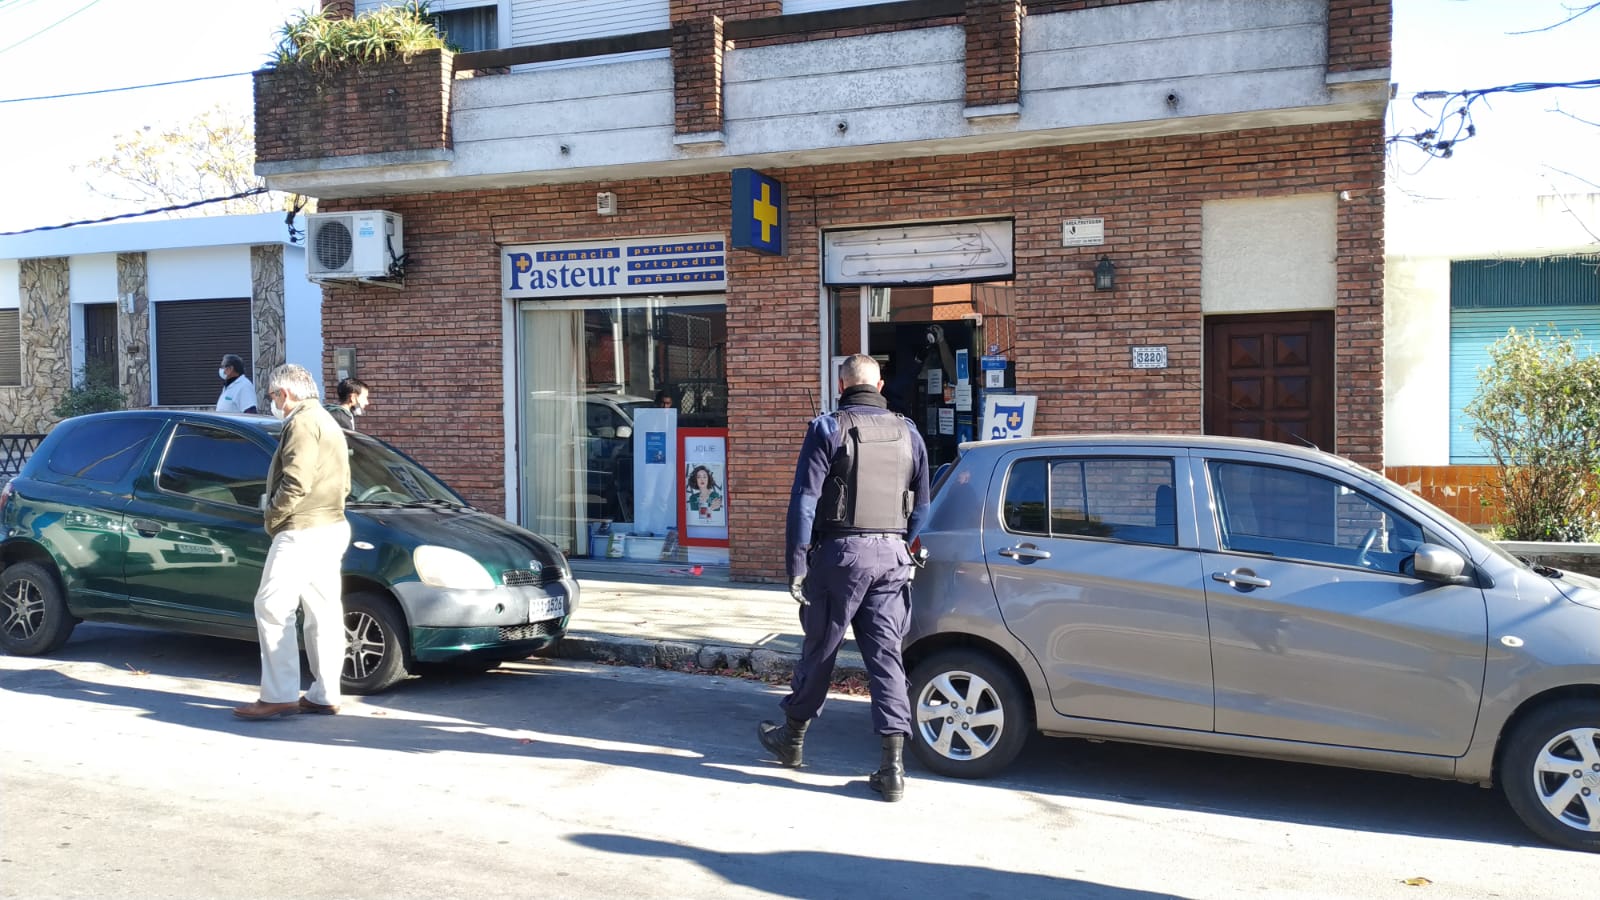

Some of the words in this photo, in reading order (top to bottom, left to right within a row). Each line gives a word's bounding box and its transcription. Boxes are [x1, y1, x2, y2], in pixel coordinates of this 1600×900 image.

[543, 248, 613, 261] farmacia
[634, 242, 716, 255] perfumeria
[634, 257, 716, 268] ortopedia
[507, 252, 621, 290] Pasteur
[1138, 352, 1161, 363] 3220
[547, 597, 562, 612] 1526
